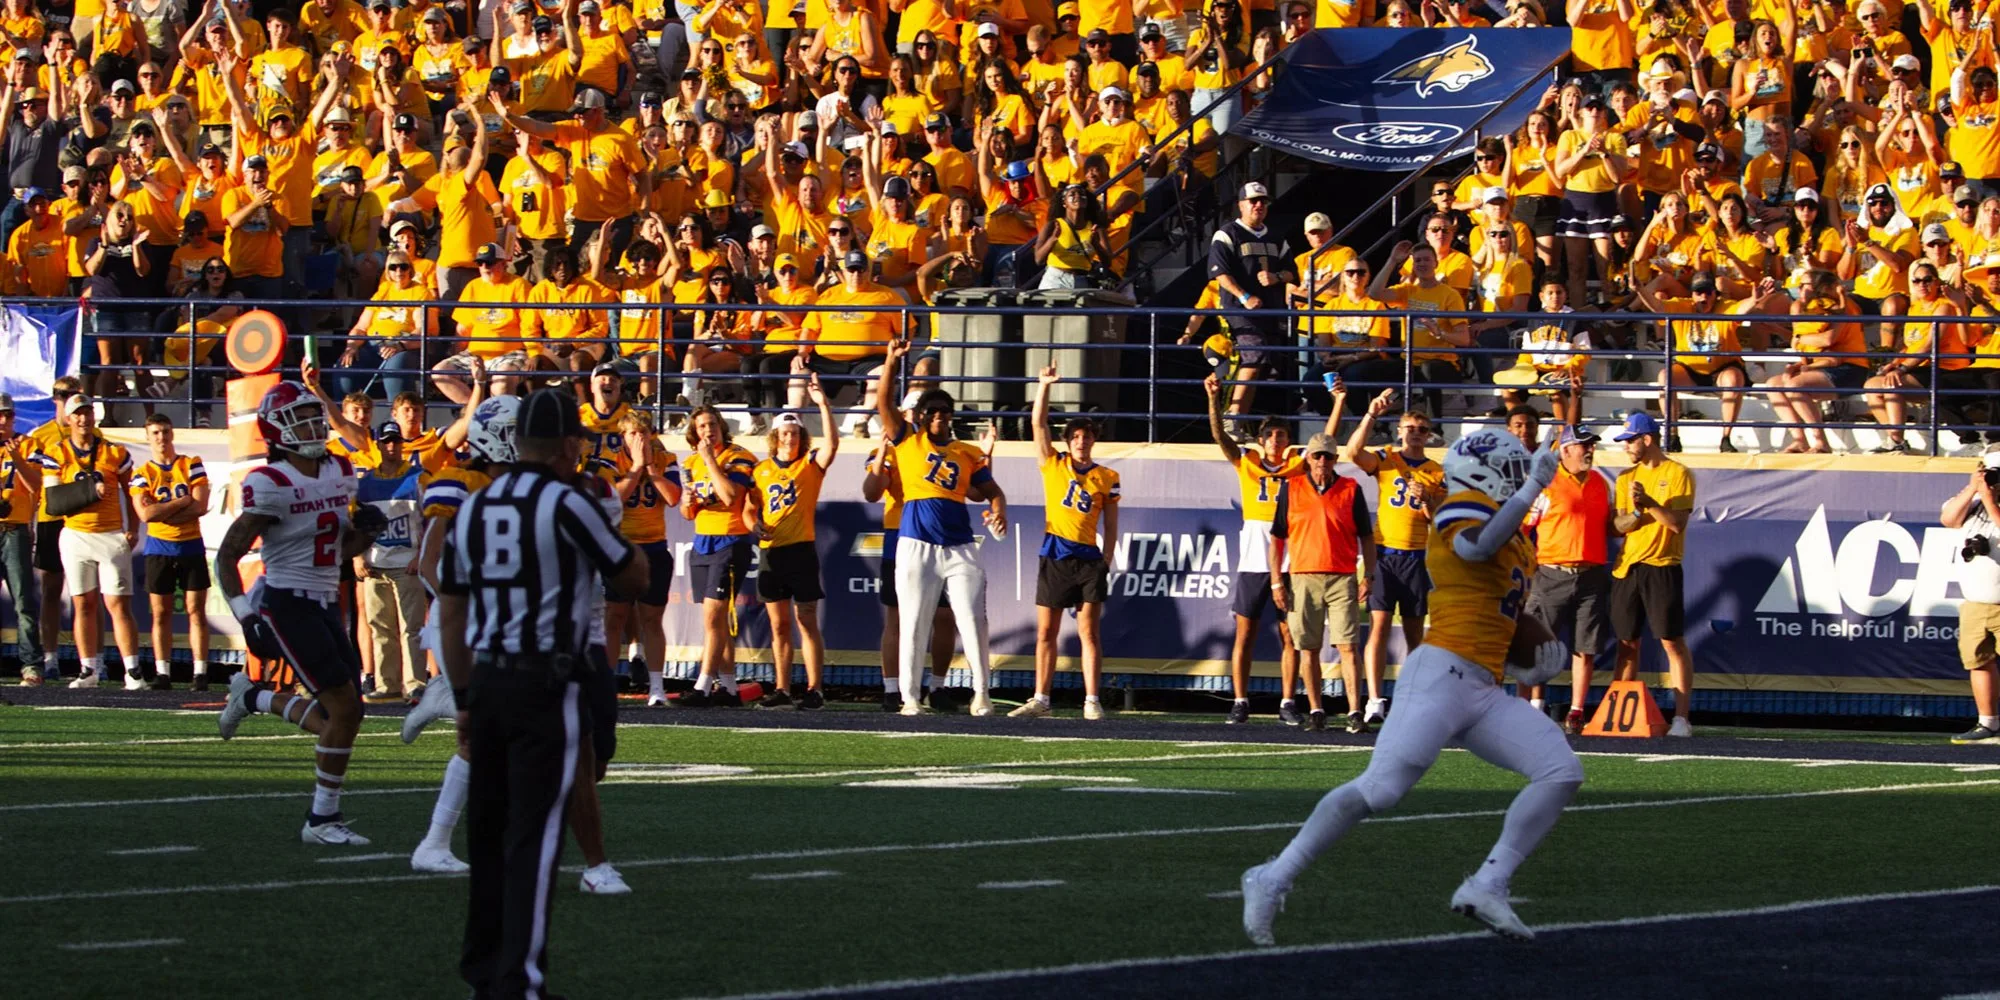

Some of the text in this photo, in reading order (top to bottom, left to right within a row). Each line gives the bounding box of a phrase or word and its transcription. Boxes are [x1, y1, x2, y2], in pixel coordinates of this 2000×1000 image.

[1251, 128, 1292, 146] YOUR
[1292, 141, 1337, 158] LOCAL
[1339, 151, 1411, 164] MONTANA
[1355, 124, 1441, 145] Ford
[926, 452, 960, 490] 73
[242, 485, 255, 508] 2
[290, 500, 325, 514] UTAH
[314, 511, 339, 567] 2
[481, 505, 522, 579] B
[1097, 532, 1229, 572] NTANA
[1123, 573, 1230, 599] DEALERS
[1756, 617, 1802, 636] The
[1811, 619, 1895, 641] helpful
[1602, 691, 1639, 732] 10
